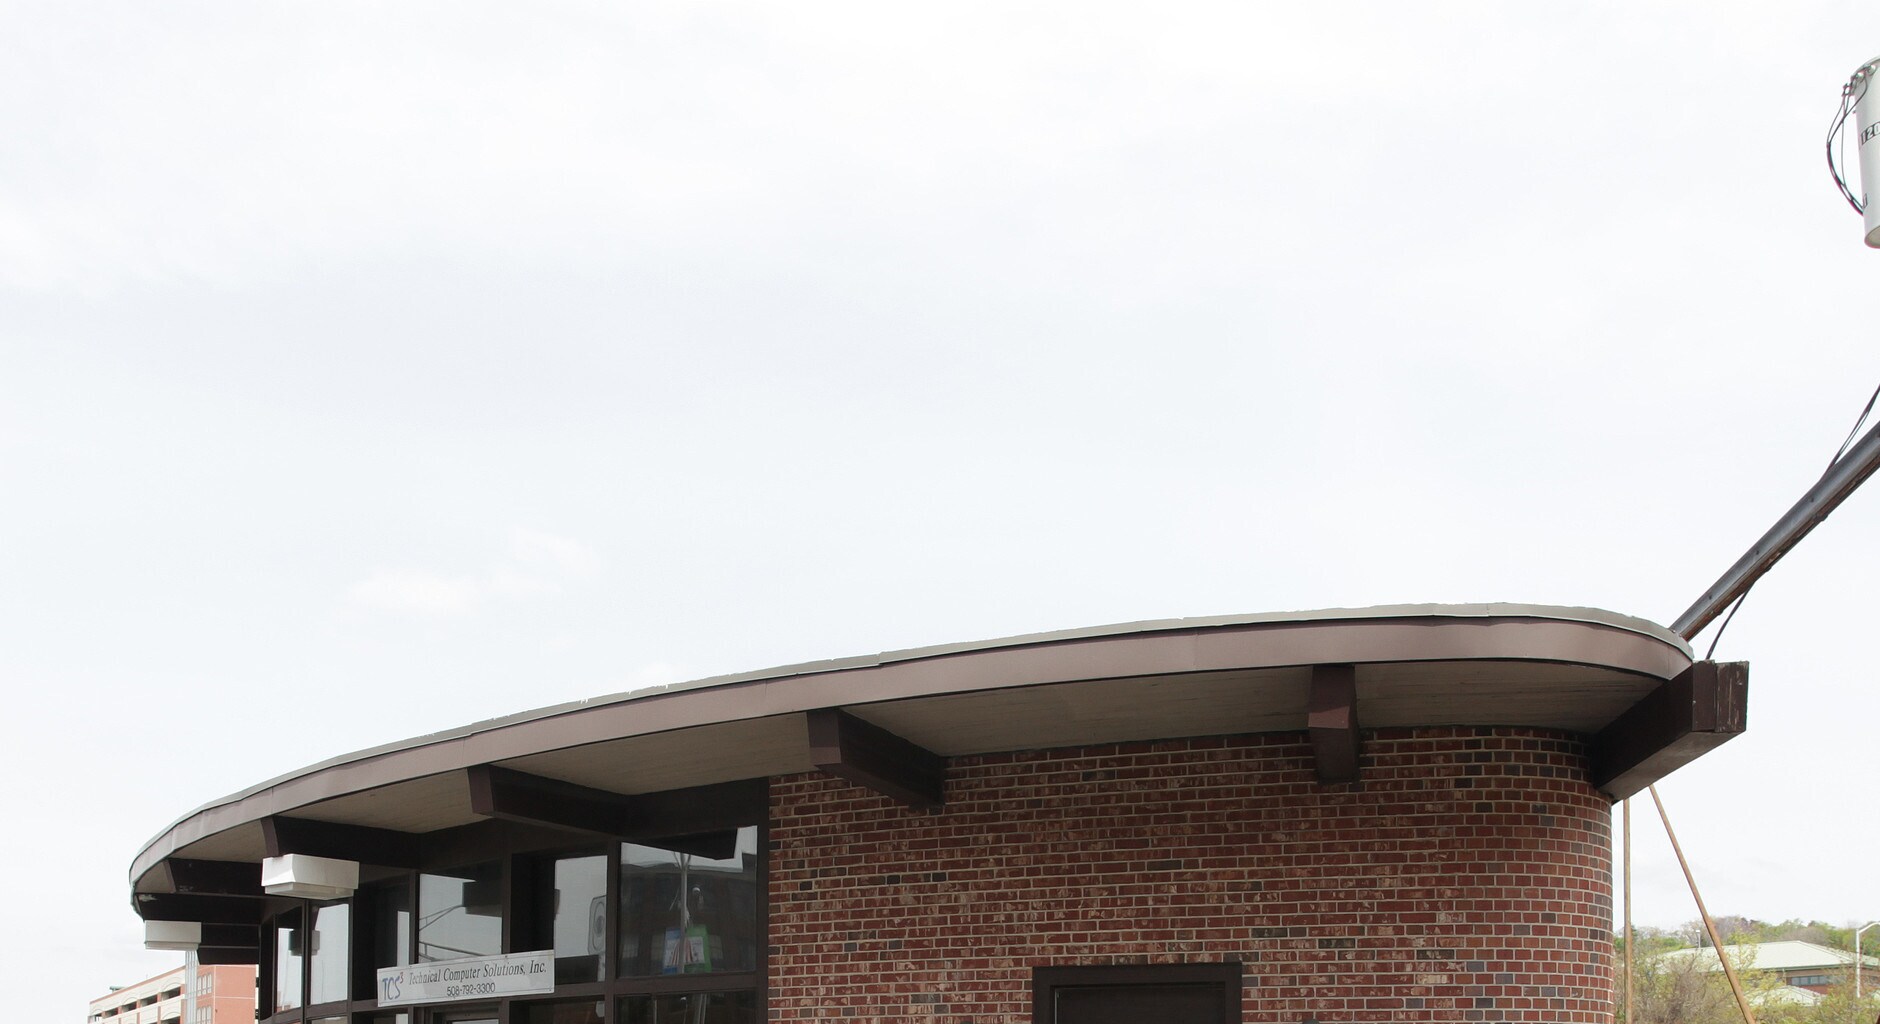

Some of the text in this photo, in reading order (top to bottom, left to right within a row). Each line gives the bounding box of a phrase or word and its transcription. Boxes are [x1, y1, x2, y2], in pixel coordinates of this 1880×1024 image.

[409, 972, 441, 986] Technical
[443, 968, 482, 982] Computer
[483, 963, 526, 978] Solutions,
[530, 960, 547, 974] Inc.
[447, 982, 496, 997] 508-792-3300
